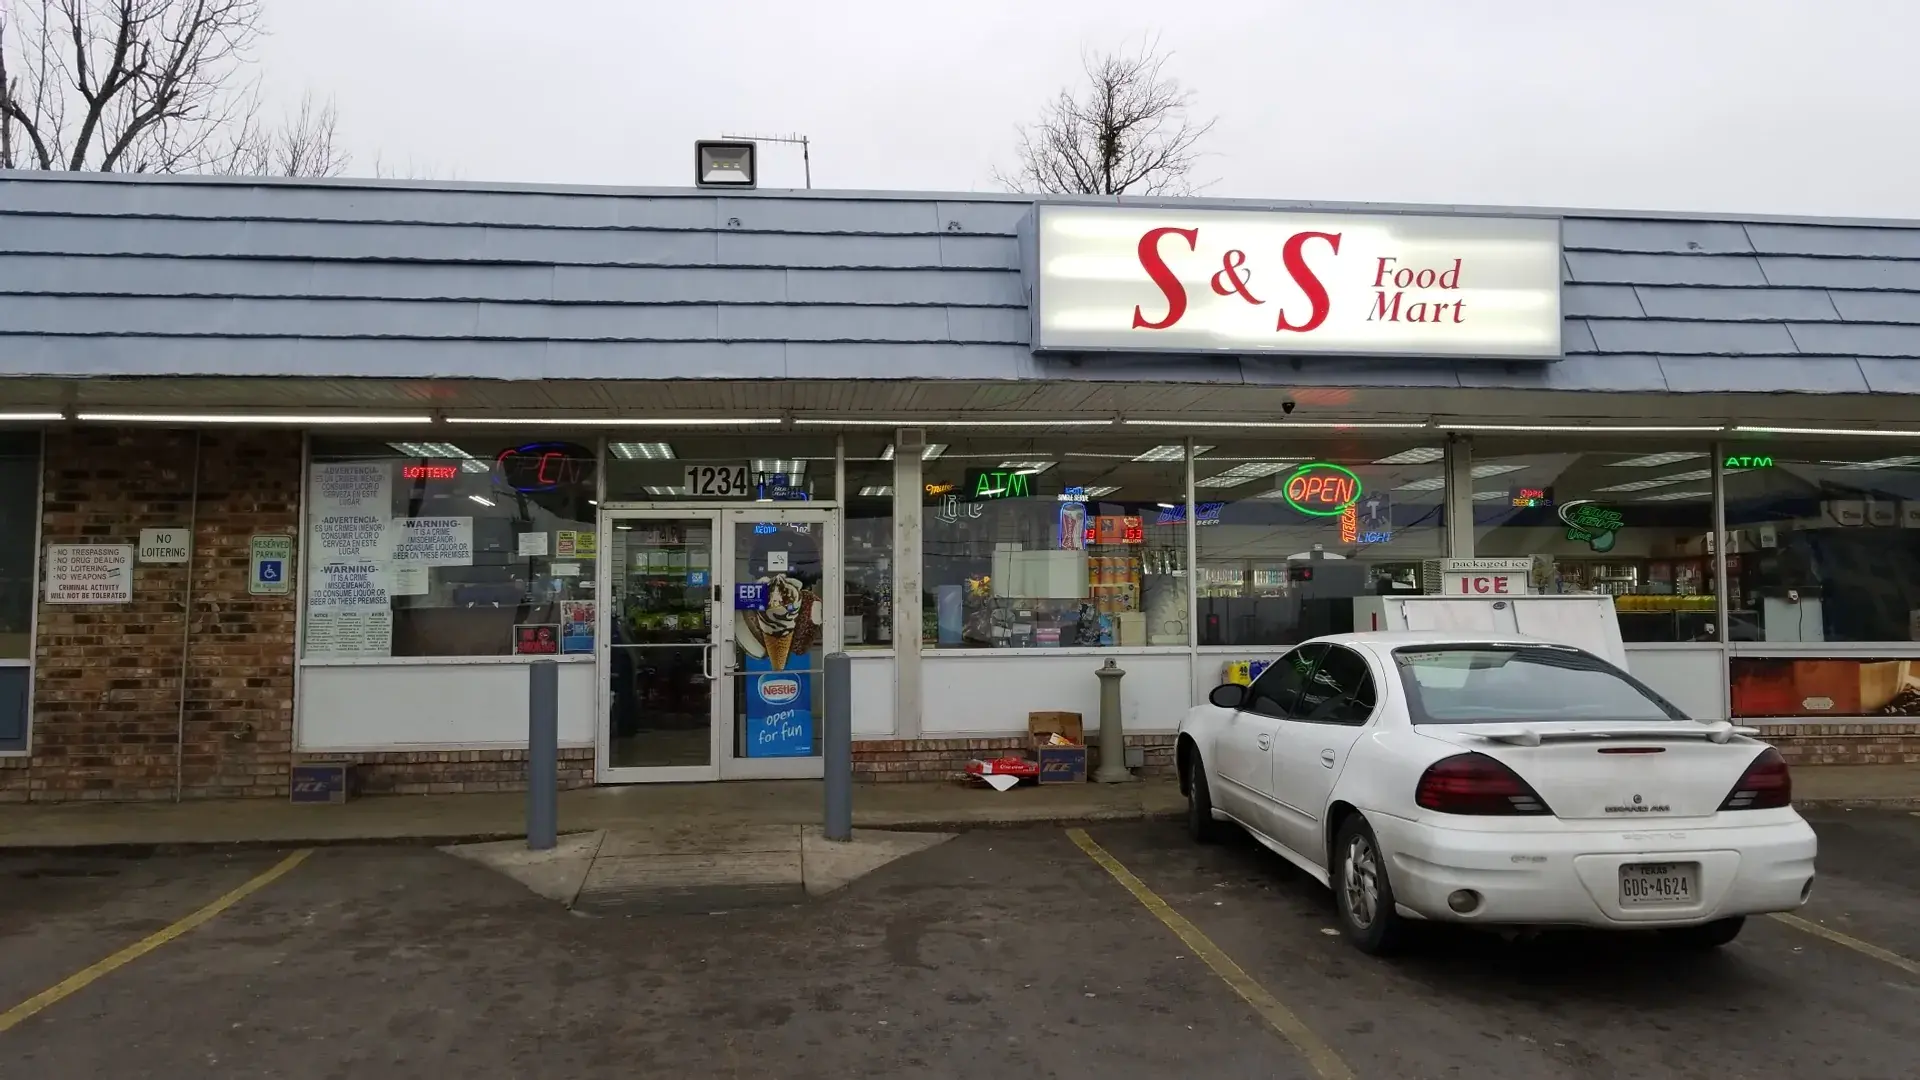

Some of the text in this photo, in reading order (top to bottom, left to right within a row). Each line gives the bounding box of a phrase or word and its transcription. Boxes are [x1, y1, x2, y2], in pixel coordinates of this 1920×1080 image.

[1371, 257, 1462, 289] Food
[1132, 227, 1341, 332] S & S
[1366, 291, 1467, 323] Mart
[1725, 457, 1773, 467] ATM
[404, 466, 457, 478] LOTTERY
[688, 466, 746, 495] 1234
[975, 473, 1029, 498] ATM
[1289, 476, 1354, 502] OPEN
[1157, 503, 1224, 522] BUCH
[315, 524, 323, 532] ES
[156, 534, 172, 544] NO
[1357, 532, 1392, 544] LIGHT
[254, 540, 289, 549] RESERVED
[322, 540, 350, 548] CERVEZA
[435, 543, 458, 551] LIQUOR
[72, 548, 119, 556] TRESPASSING
[141, 547, 185, 557] LOITERING
[255, 550, 287, 559] PARKING
[392, 552, 409, 560] BEER
[410, 551, 419, 559] ON
[420, 551, 439, 559] THESE
[1452, 560, 1507, 568] packaged
[349, 573, 368, 581] CRIME
[1462, 576, 1508, 593] ICE
[353, 589, 376, 597] LIQUOR
[740, 585, 762, 599] EBT
[310, 598, 326, 606] BEER
[338, 597, 357, 605] THESE
[766, 708, 794, 727] open
[758, 721, 802, 744] for fun
[1043, 762, 1072, 773] ICE
[1640, 866, 1667, 875] TEXAS
